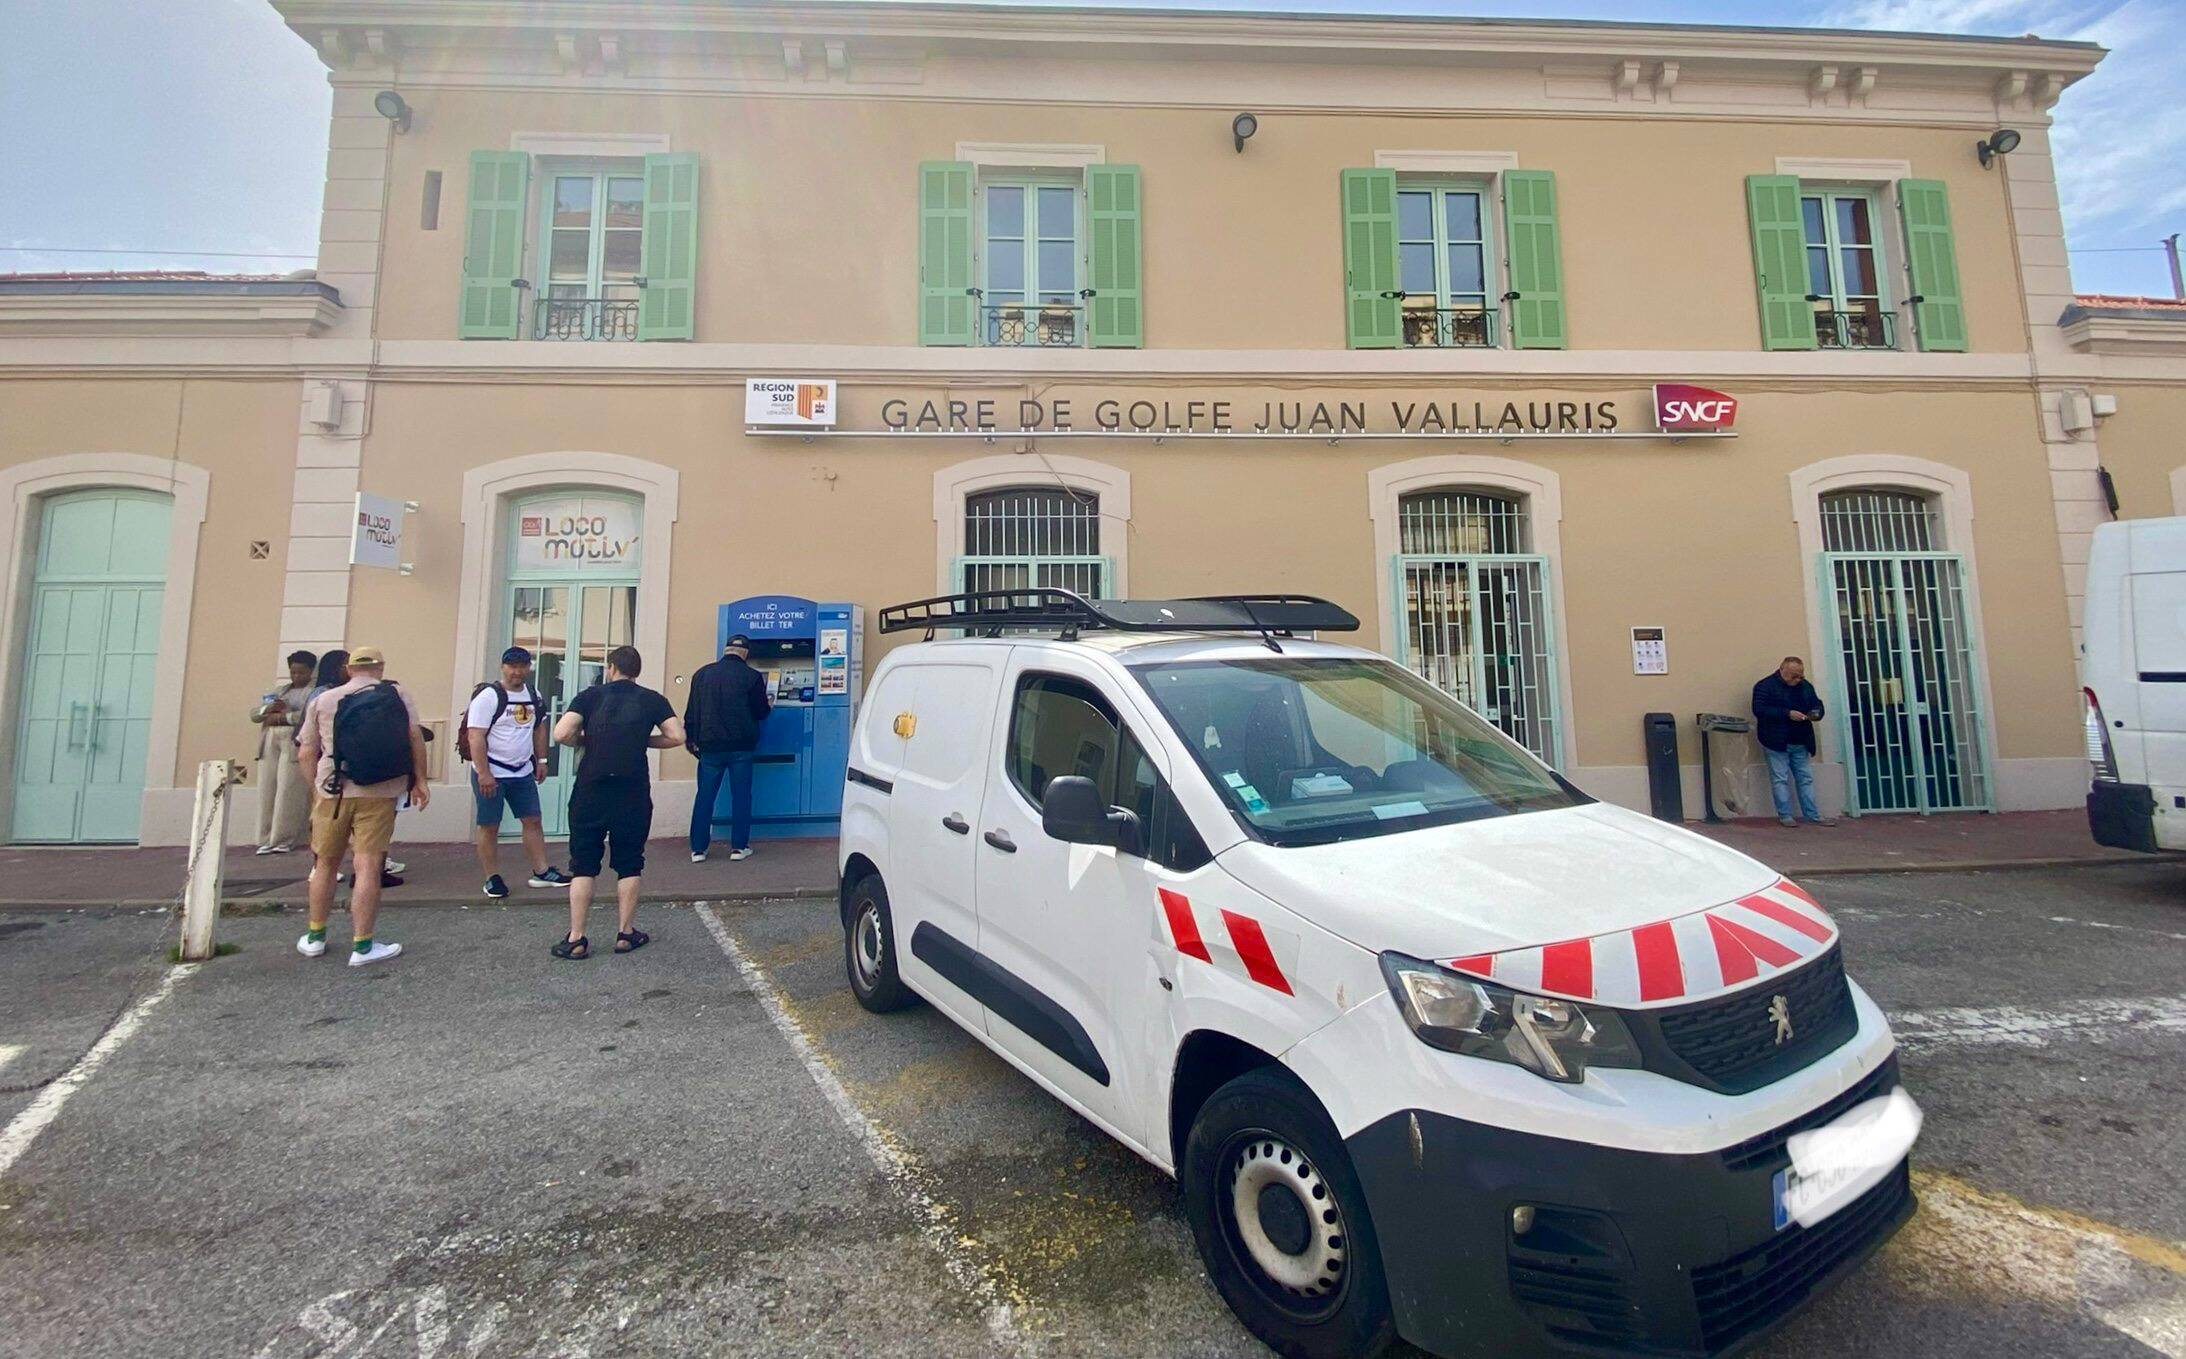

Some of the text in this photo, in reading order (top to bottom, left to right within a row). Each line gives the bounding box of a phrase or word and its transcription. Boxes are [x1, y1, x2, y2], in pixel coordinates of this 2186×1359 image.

[772, 393, 795, 402] SUD
[881, 399, 1618, 430] GARE DE GOLFE JUAN VALLAURIS
[1662, 401, 1733, 422] SNCF
[544, 517, 605, 536] LOCO
[739, 611, 805, 620] ACHETEZ VOTRE
[749, 620, 794, 629] BILLET TER
